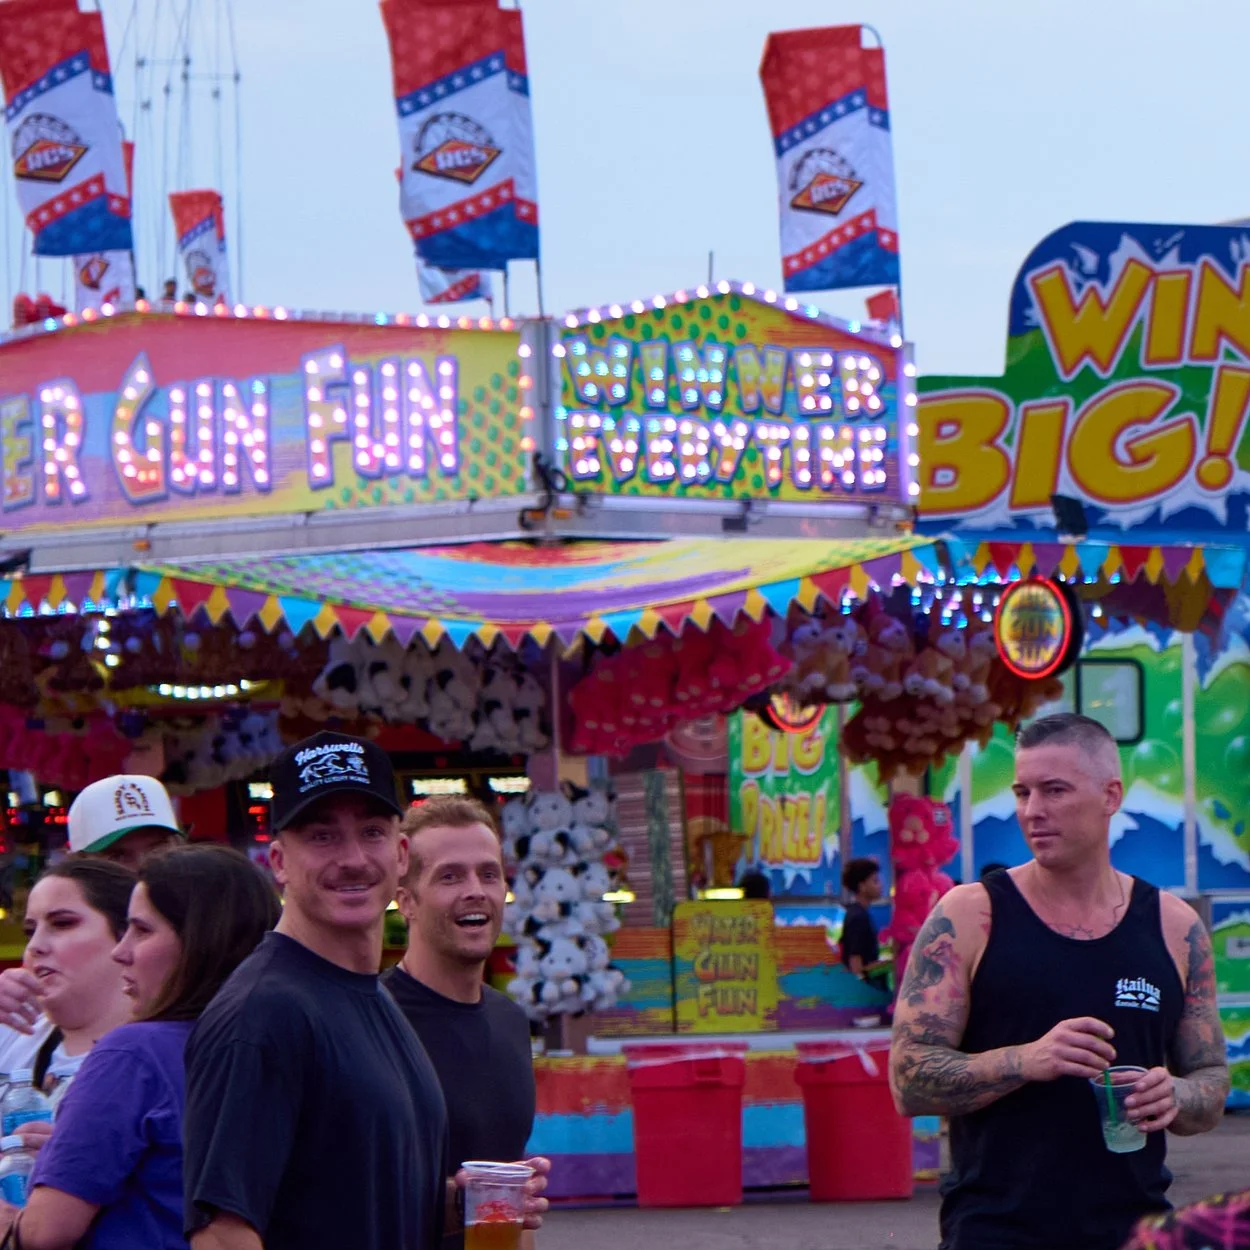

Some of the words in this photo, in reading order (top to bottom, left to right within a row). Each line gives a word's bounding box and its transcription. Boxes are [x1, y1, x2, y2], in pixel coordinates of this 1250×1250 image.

[562, 335, 887, 418] WINNER
[110, 350, 270, 505] GUN
[300, 344, 459, 492] FUN
[742, 711, 824, 775] BIG
